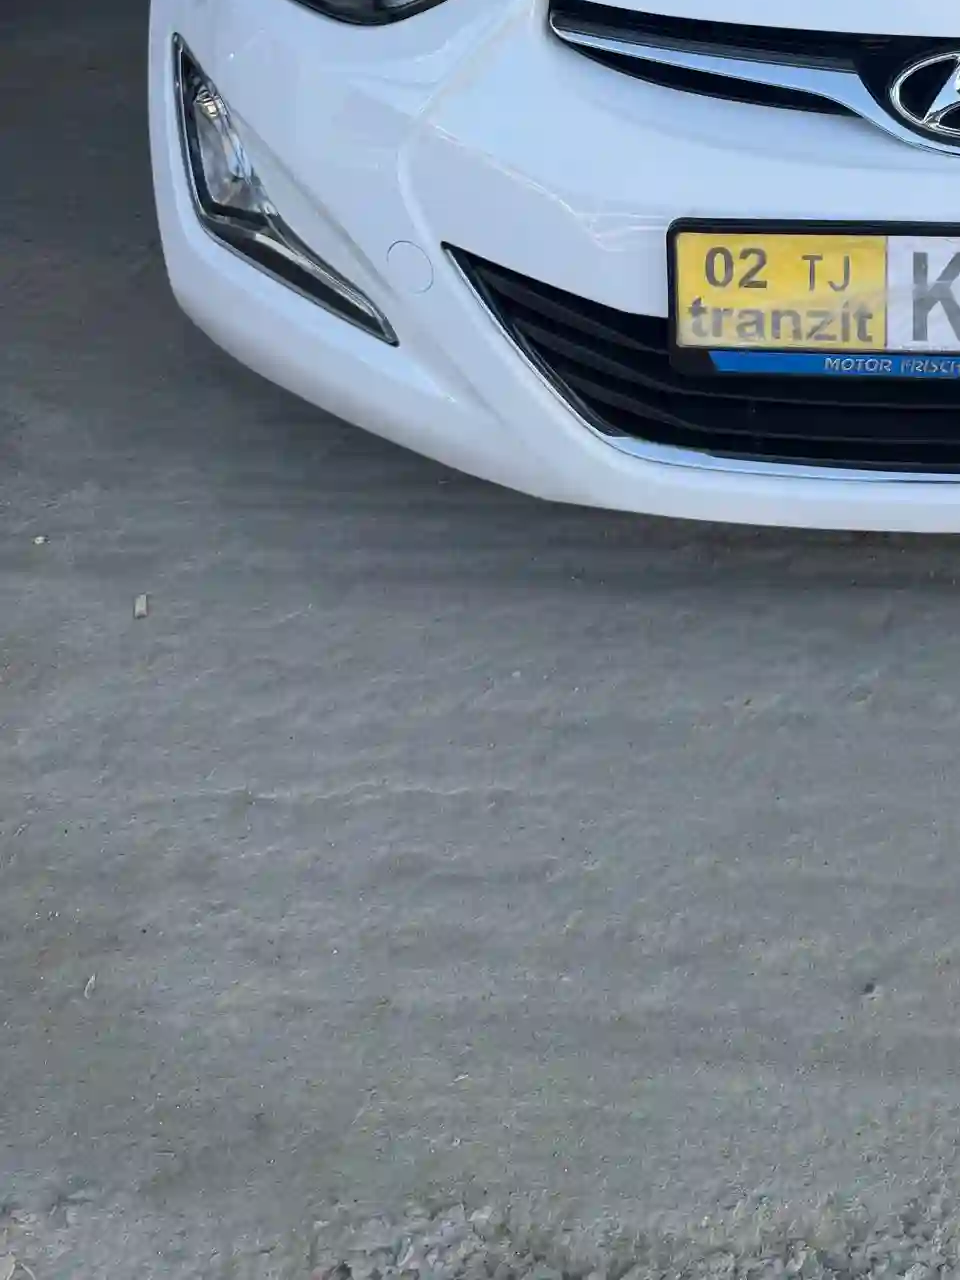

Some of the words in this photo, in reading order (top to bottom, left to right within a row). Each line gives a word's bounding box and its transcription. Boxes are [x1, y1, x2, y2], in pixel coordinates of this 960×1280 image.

[705, 246, 767, 288] 02
[802, 254, 850, 291] TJ
[688, 297, 873, 342] tranzit
[824, 357, 892, 373] MOTOR
